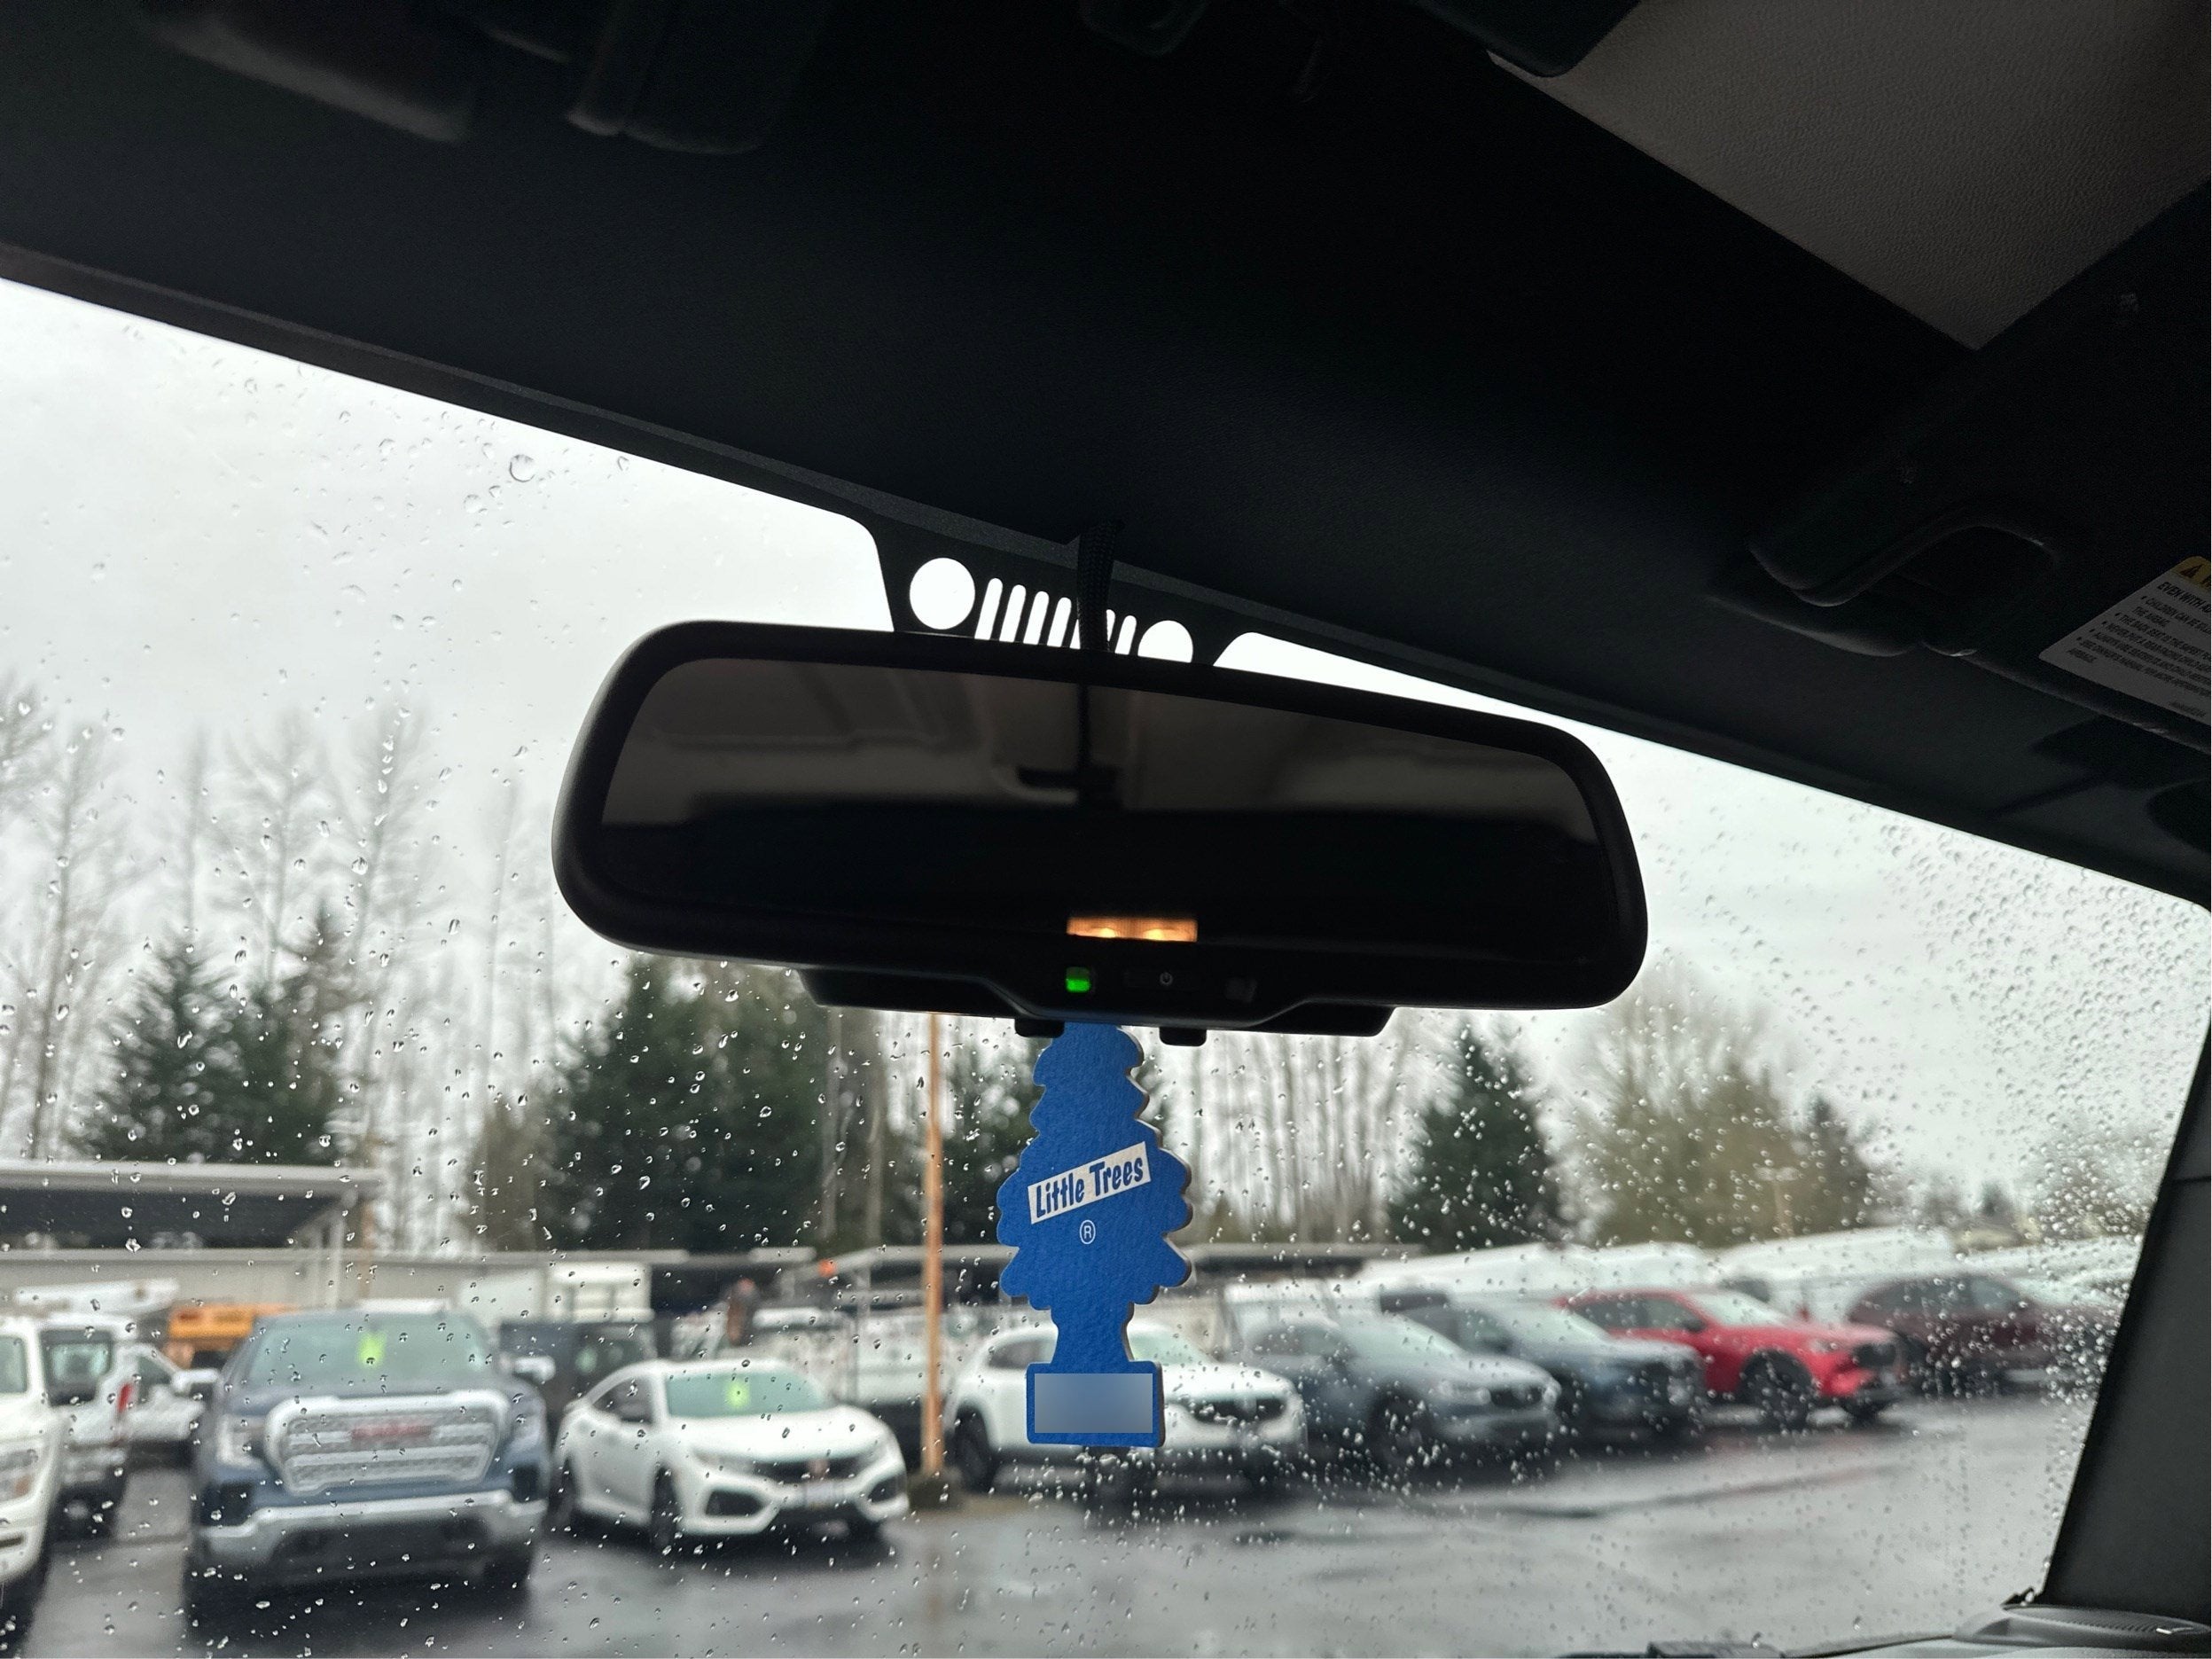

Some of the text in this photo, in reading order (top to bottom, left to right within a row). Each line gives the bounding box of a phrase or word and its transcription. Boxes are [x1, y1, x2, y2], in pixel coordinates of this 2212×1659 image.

[2157, 583, 2185, 597] EVEN
[1036, 1157, 1144, 1218] Little Trees
